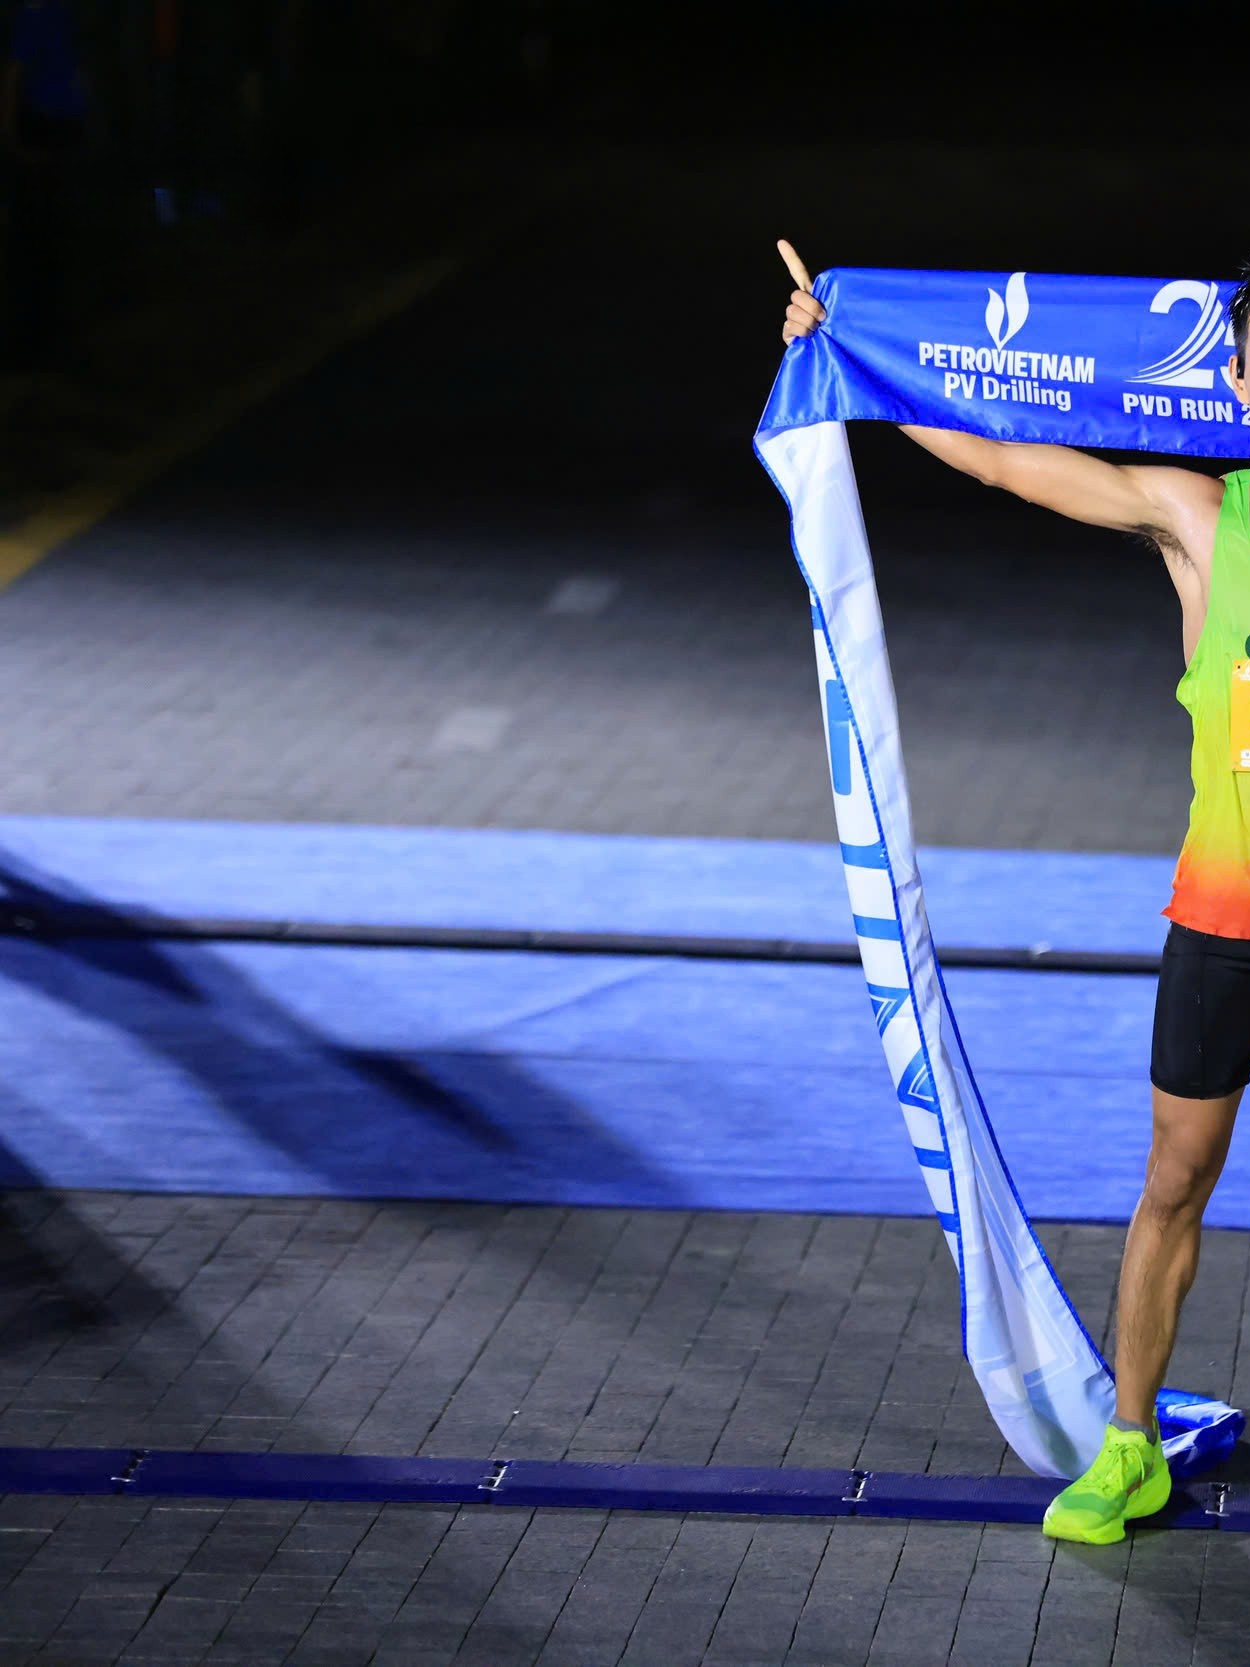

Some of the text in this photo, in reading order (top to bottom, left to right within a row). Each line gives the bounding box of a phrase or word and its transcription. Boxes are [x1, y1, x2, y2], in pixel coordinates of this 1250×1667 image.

[1124, 280, 1237, 391] 2
[919, 342, 1095, 384] PETROVIETNAM
[944, 372, 1071, 412] PV Drilling
[1122, 393, 1173, 417] PVD
[1180, 398, 1234, 424] RUN
